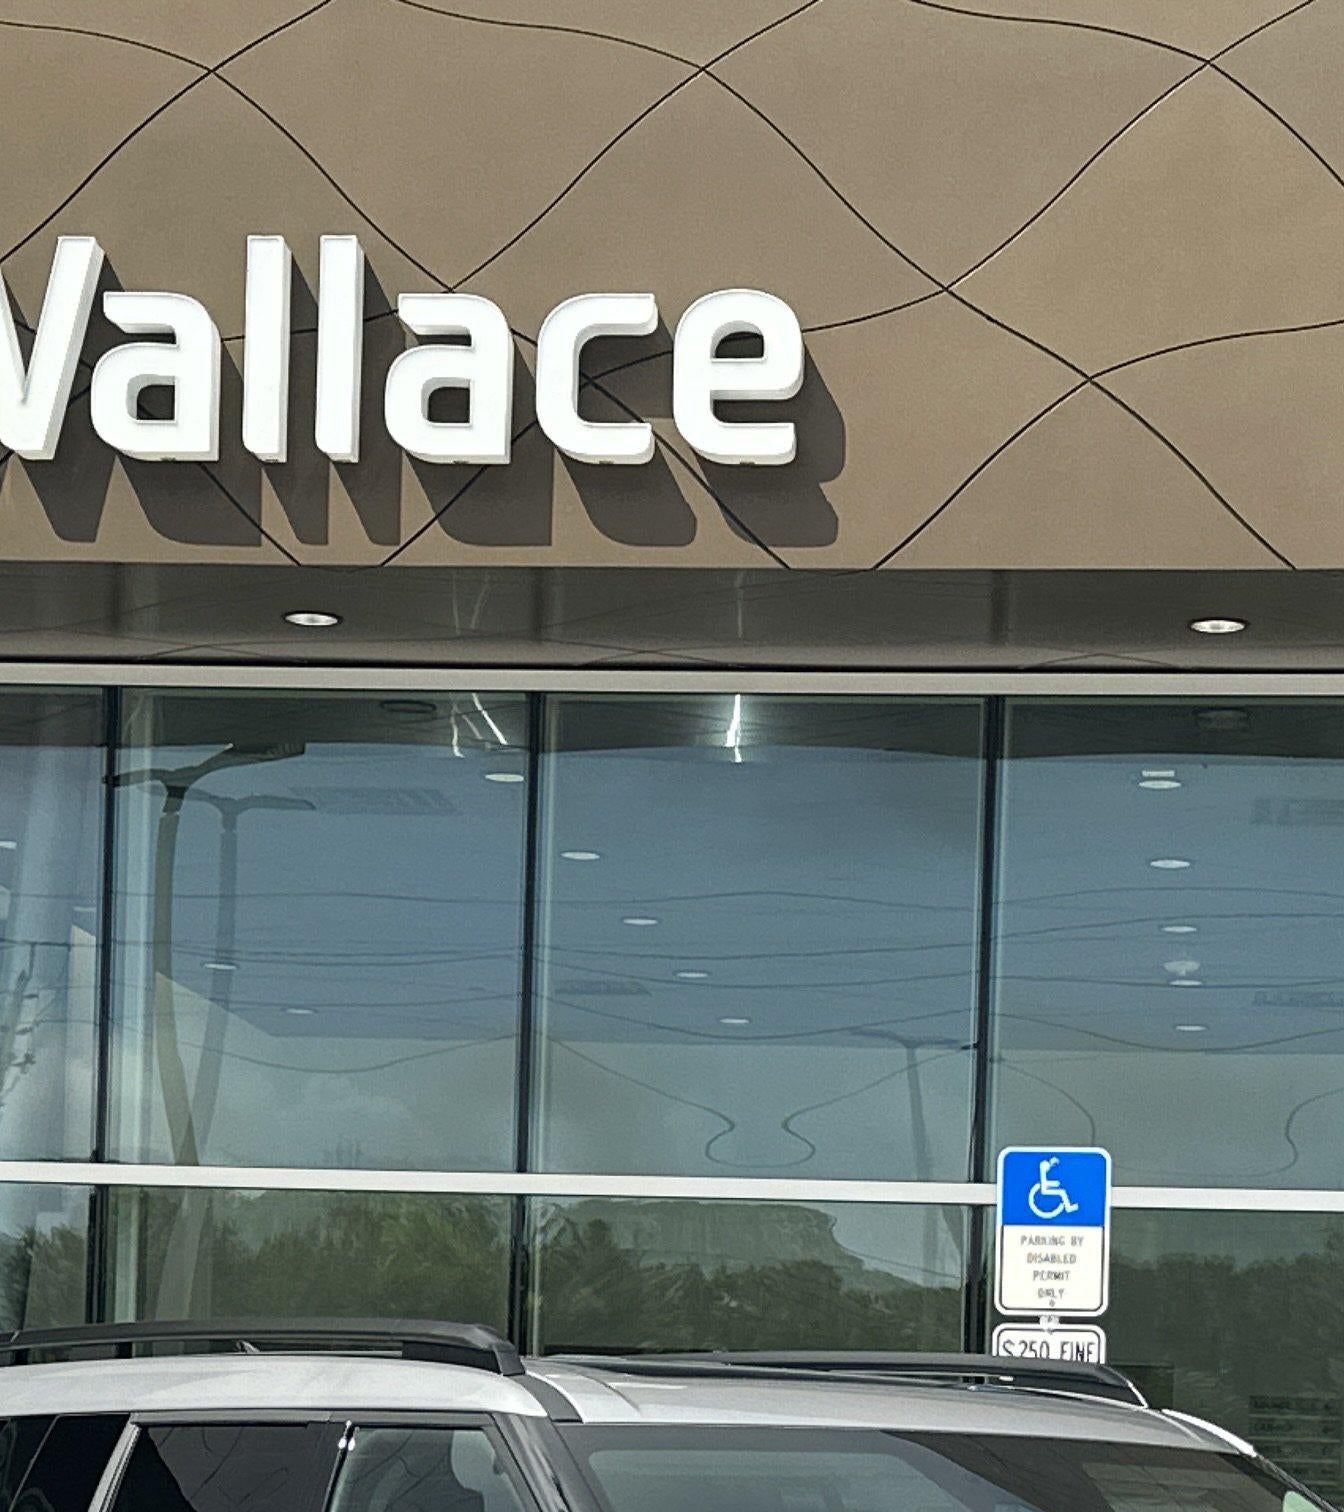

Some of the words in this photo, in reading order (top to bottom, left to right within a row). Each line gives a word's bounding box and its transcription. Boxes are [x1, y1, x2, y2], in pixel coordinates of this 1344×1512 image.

[1020, 1235, 1066, 1246] PARKING
[1070, 1236, 1085, 1247] BY
[1026, 1253, 1077, 1265] DISABLED
[1032, 1270, 1071, 1282] PERMIT
[1037, 1287, 1065, 1299] ONLY
